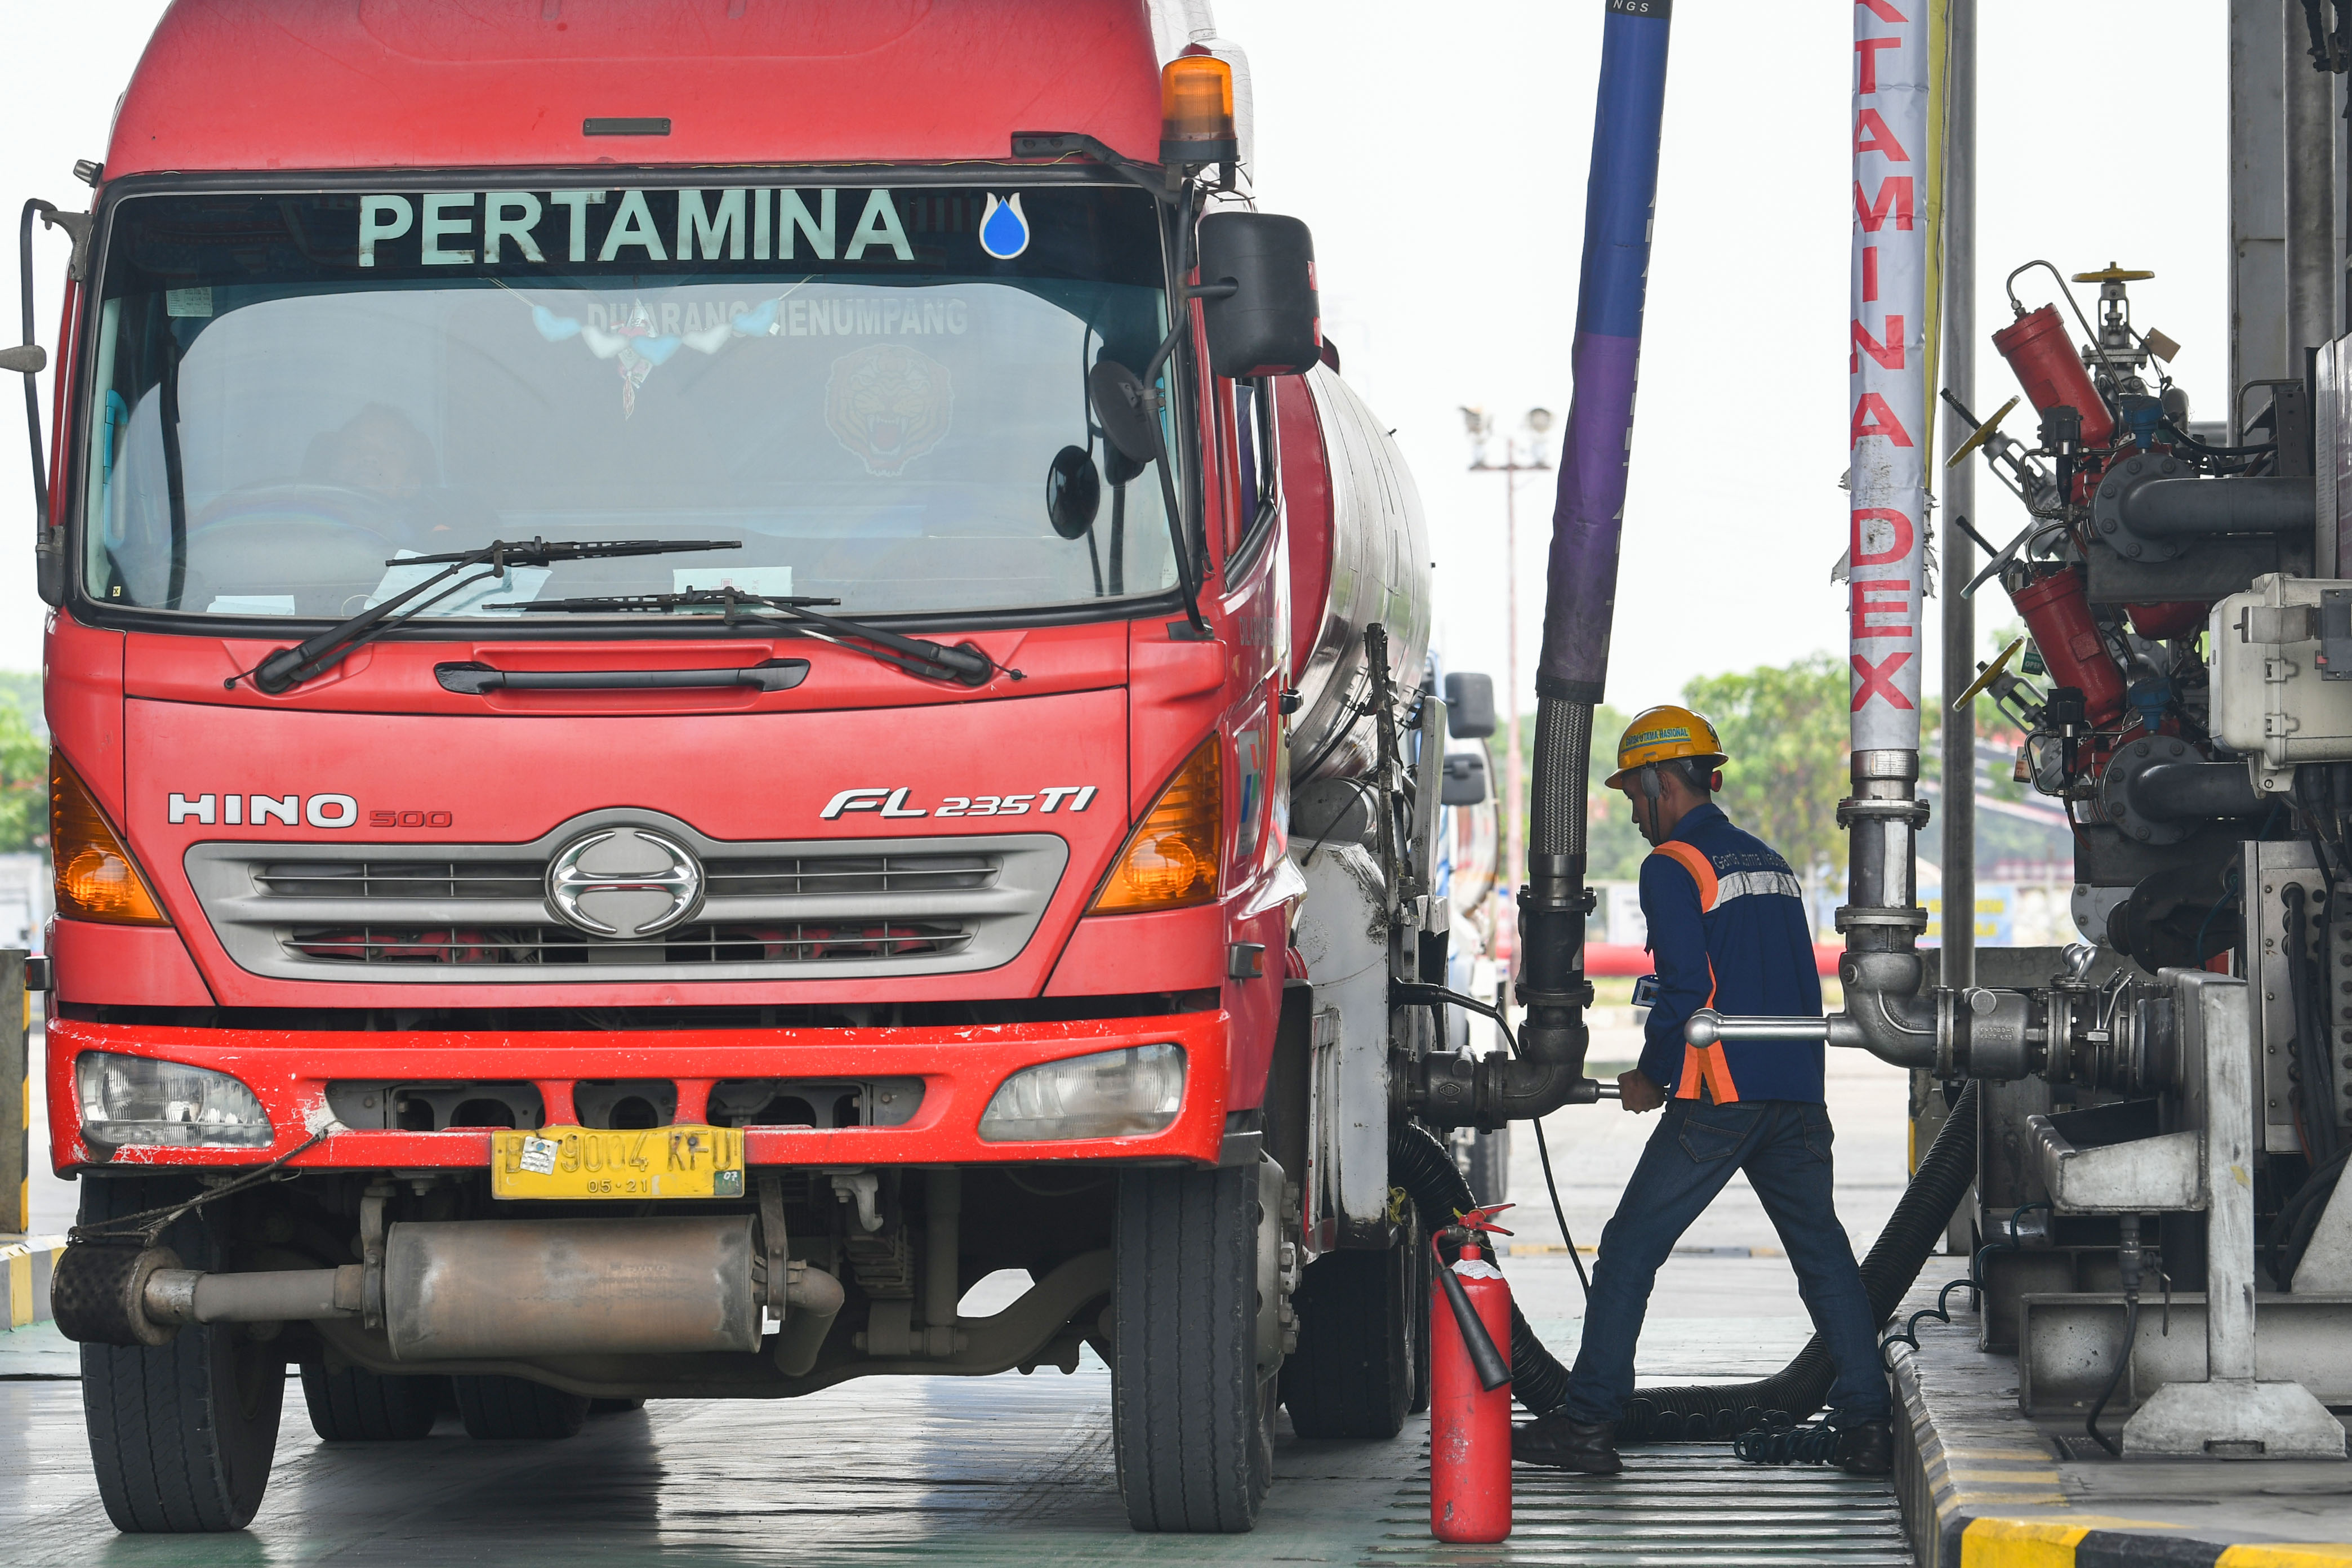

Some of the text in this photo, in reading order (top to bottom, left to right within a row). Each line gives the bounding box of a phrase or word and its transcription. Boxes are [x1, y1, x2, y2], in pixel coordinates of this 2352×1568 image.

[359, 189, 915, 268] PERTAMINA
[1659, 727, 1689, 740] NASIONAL
[168, 792, 453, 828] HINO 500
[819, 787, 929, 821] FL
[667, 1131, 732, 1171] KFU
